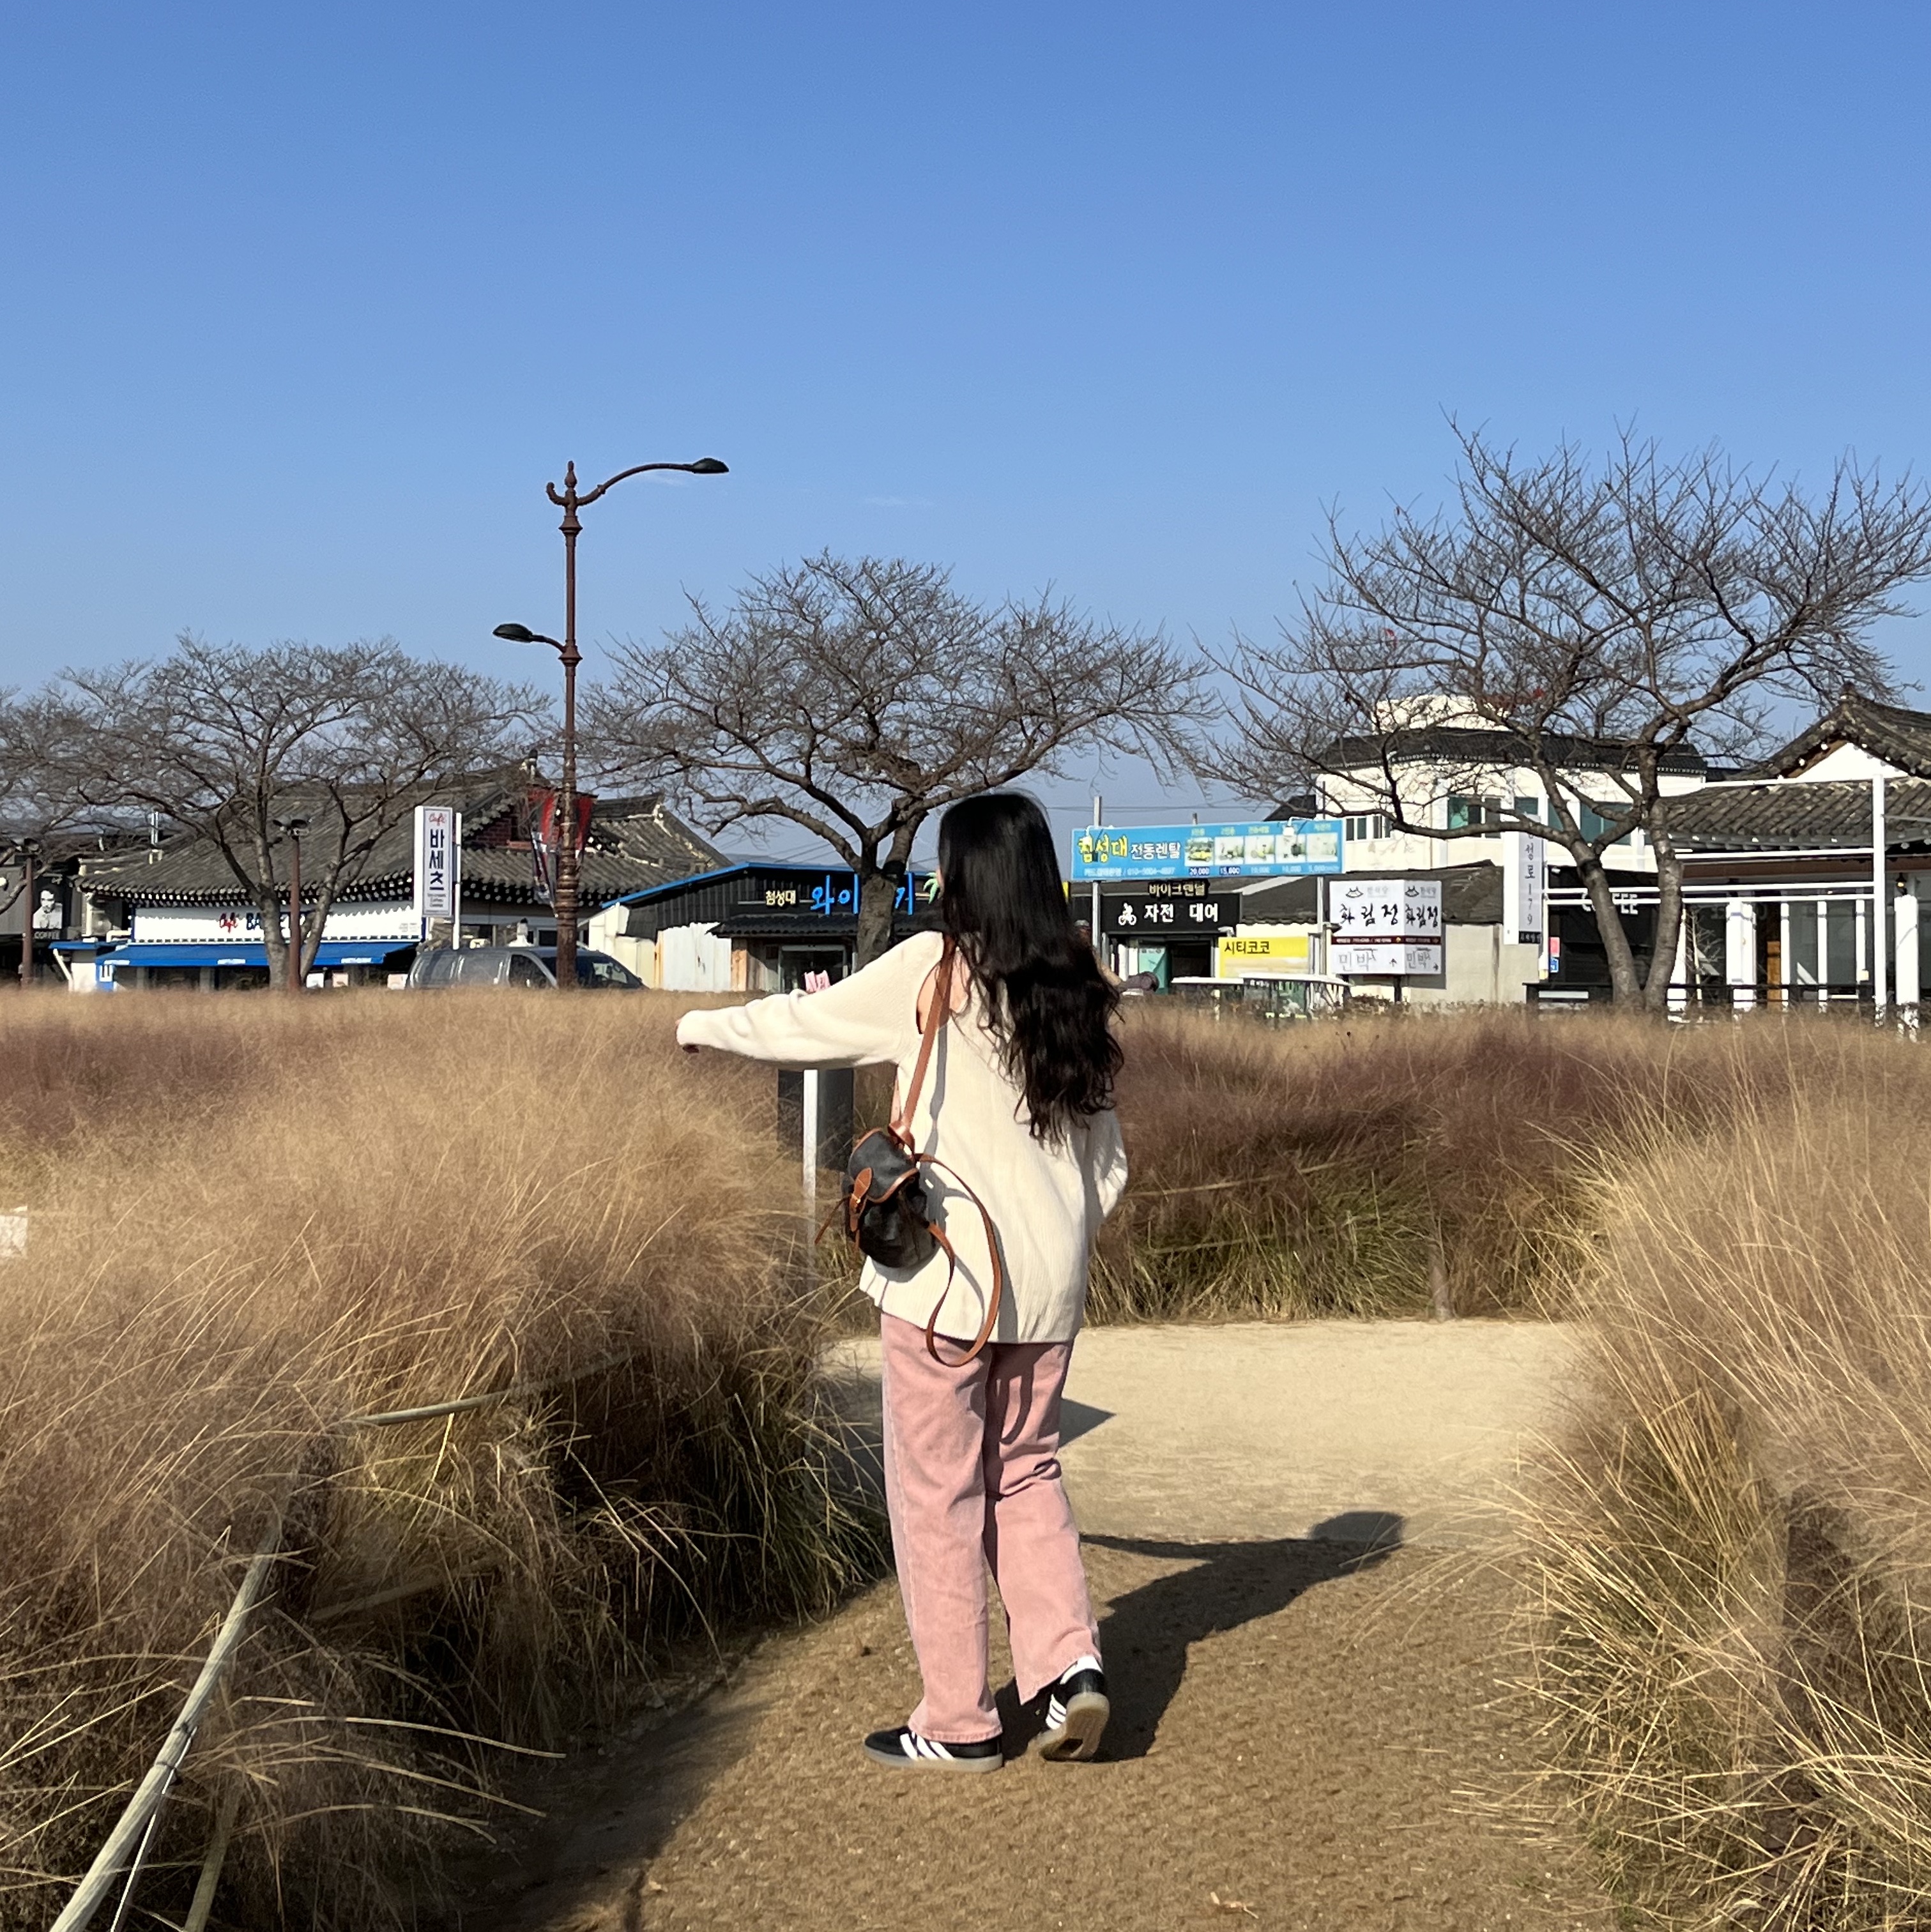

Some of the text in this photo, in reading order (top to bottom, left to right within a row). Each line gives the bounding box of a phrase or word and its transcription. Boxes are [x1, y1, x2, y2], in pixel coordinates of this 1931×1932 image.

[1130, 842, 1181, 861] 전동렌탈
[766, 890, 797, 907] 첨성대
[1189, 903, 1218, 922] 대여
[1225, 941, 1270, 954] 시티코코
